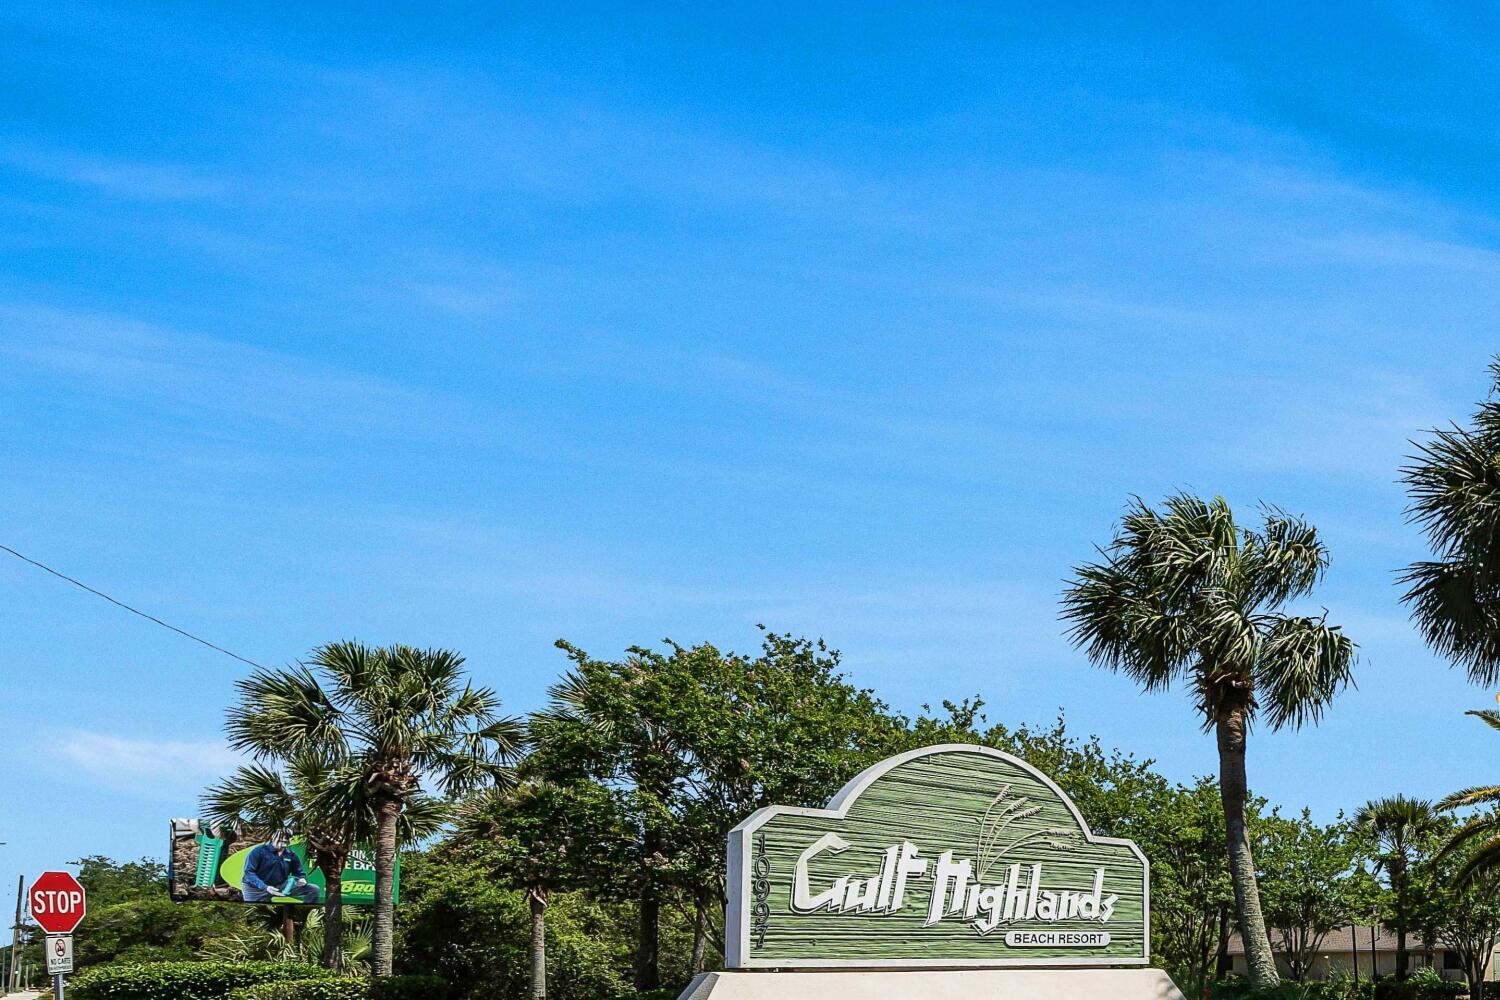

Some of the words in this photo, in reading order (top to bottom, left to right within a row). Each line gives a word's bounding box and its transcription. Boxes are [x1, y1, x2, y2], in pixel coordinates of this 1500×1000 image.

[34, 890, 82, 914] STOP
[754, 834, 771, 949] 10997
[790, 832, 927, 915] Gulf
[923, 850, 1119, 936] Highlands
[1013, 933, 1055, 944] BEACH
[1058, 933, 1104, 944] RESORT
